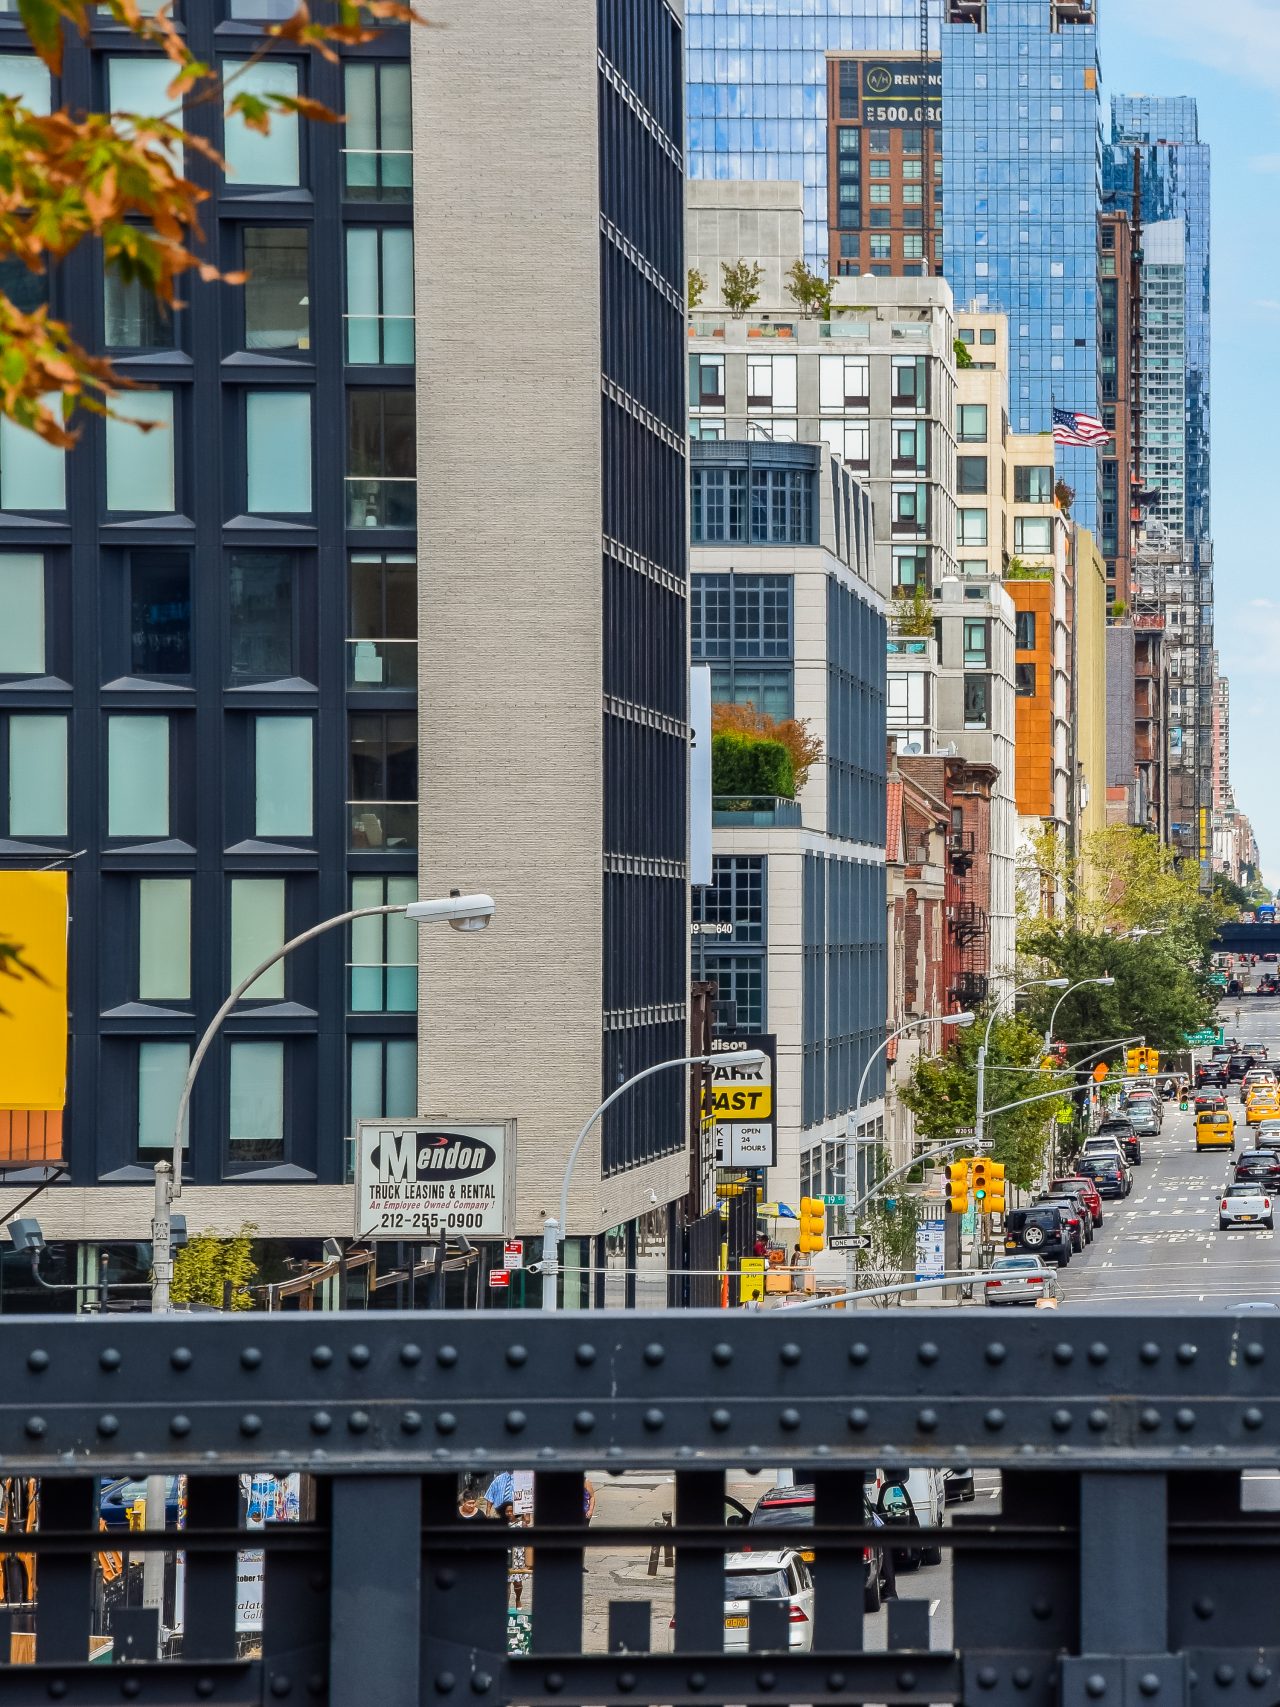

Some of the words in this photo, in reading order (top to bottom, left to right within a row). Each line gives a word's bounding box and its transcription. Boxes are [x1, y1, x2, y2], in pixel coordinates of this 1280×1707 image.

[709, 1039, 747, 1051] dison
[379, 1131, 486, 1183] Mendon
[369, 1185, 401, 1200] TRUCK
[405, 1185, 445, 1200] LEASING
[449, 1185, 456, 1199] &
[461, 1185, 496, 1199] RENTAL
[369, 1200, 381, 1210] An
[383, 1200, 421, 1210] Employee
[424, 1200, 451, 1209] Owned
[453, 1200, 489, 1211] Company
[828, 1196, 836, 1204] 19
[381, 1213, 483, 1228] 212-255-0900
